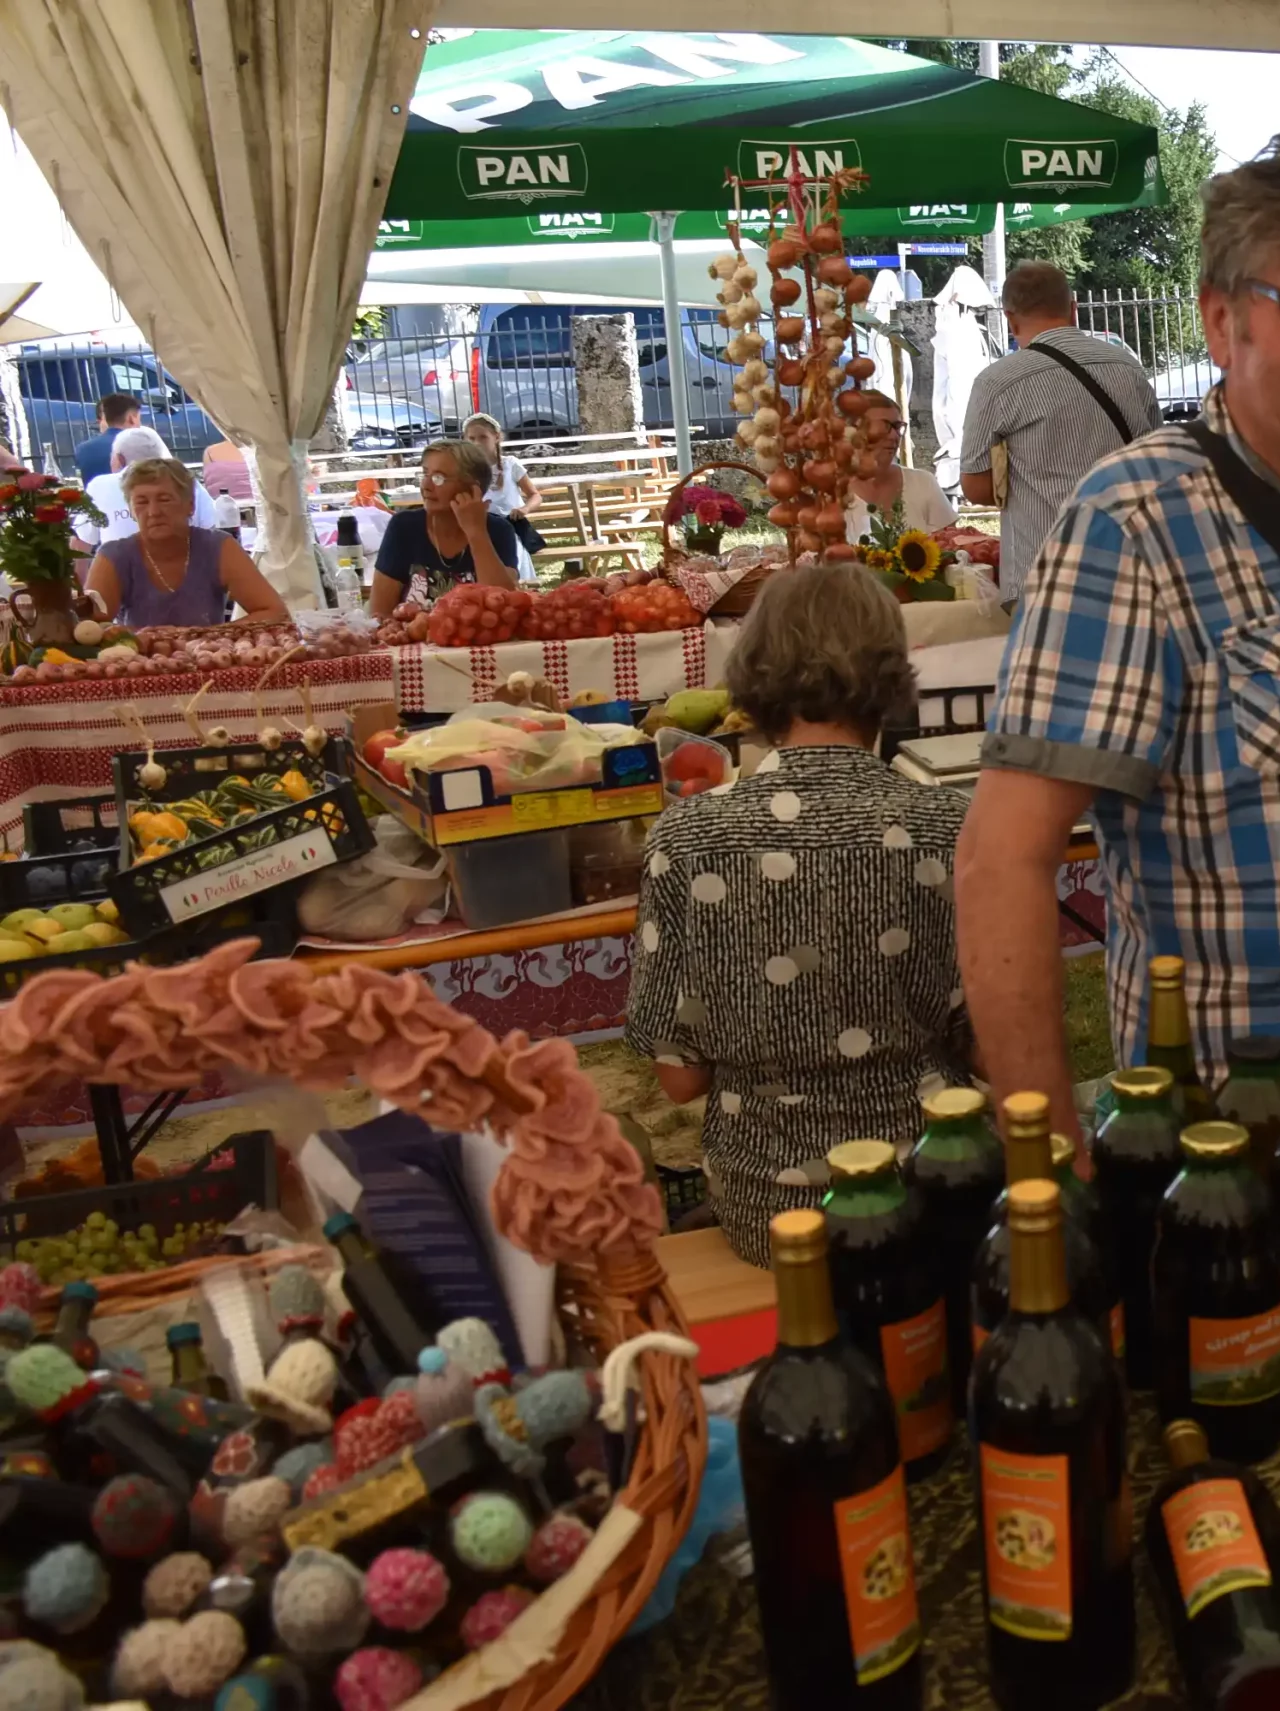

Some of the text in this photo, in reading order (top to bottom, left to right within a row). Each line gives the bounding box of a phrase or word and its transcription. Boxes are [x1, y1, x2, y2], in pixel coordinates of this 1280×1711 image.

[409, 33, 807, 133] PAN
[476, 155, 570, 186] PAN
[755, 149, 845, 178] PAN
[1021, 150, 1102, 176] PAN
